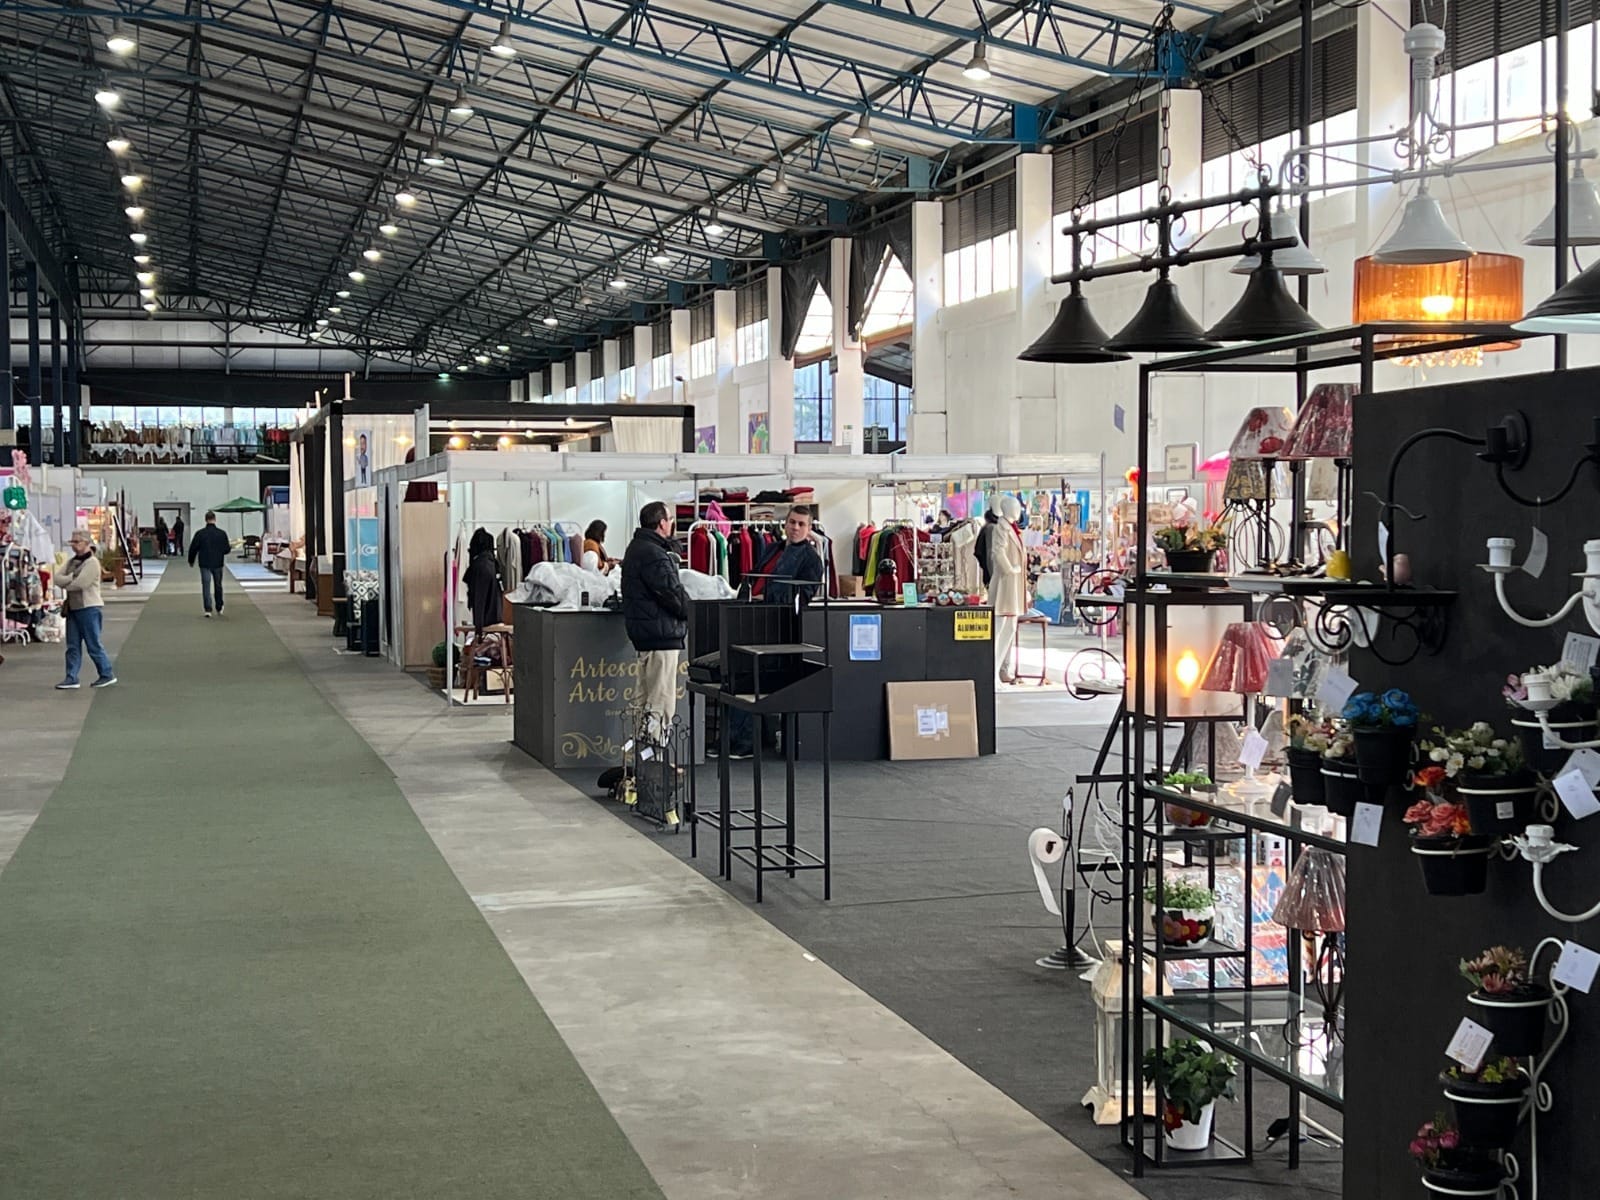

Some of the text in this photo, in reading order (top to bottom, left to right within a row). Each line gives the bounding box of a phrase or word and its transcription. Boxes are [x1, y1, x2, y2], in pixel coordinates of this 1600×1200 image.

[864, 429, 888, 439] SADA
[568, 681, 637, 703] Arte e
